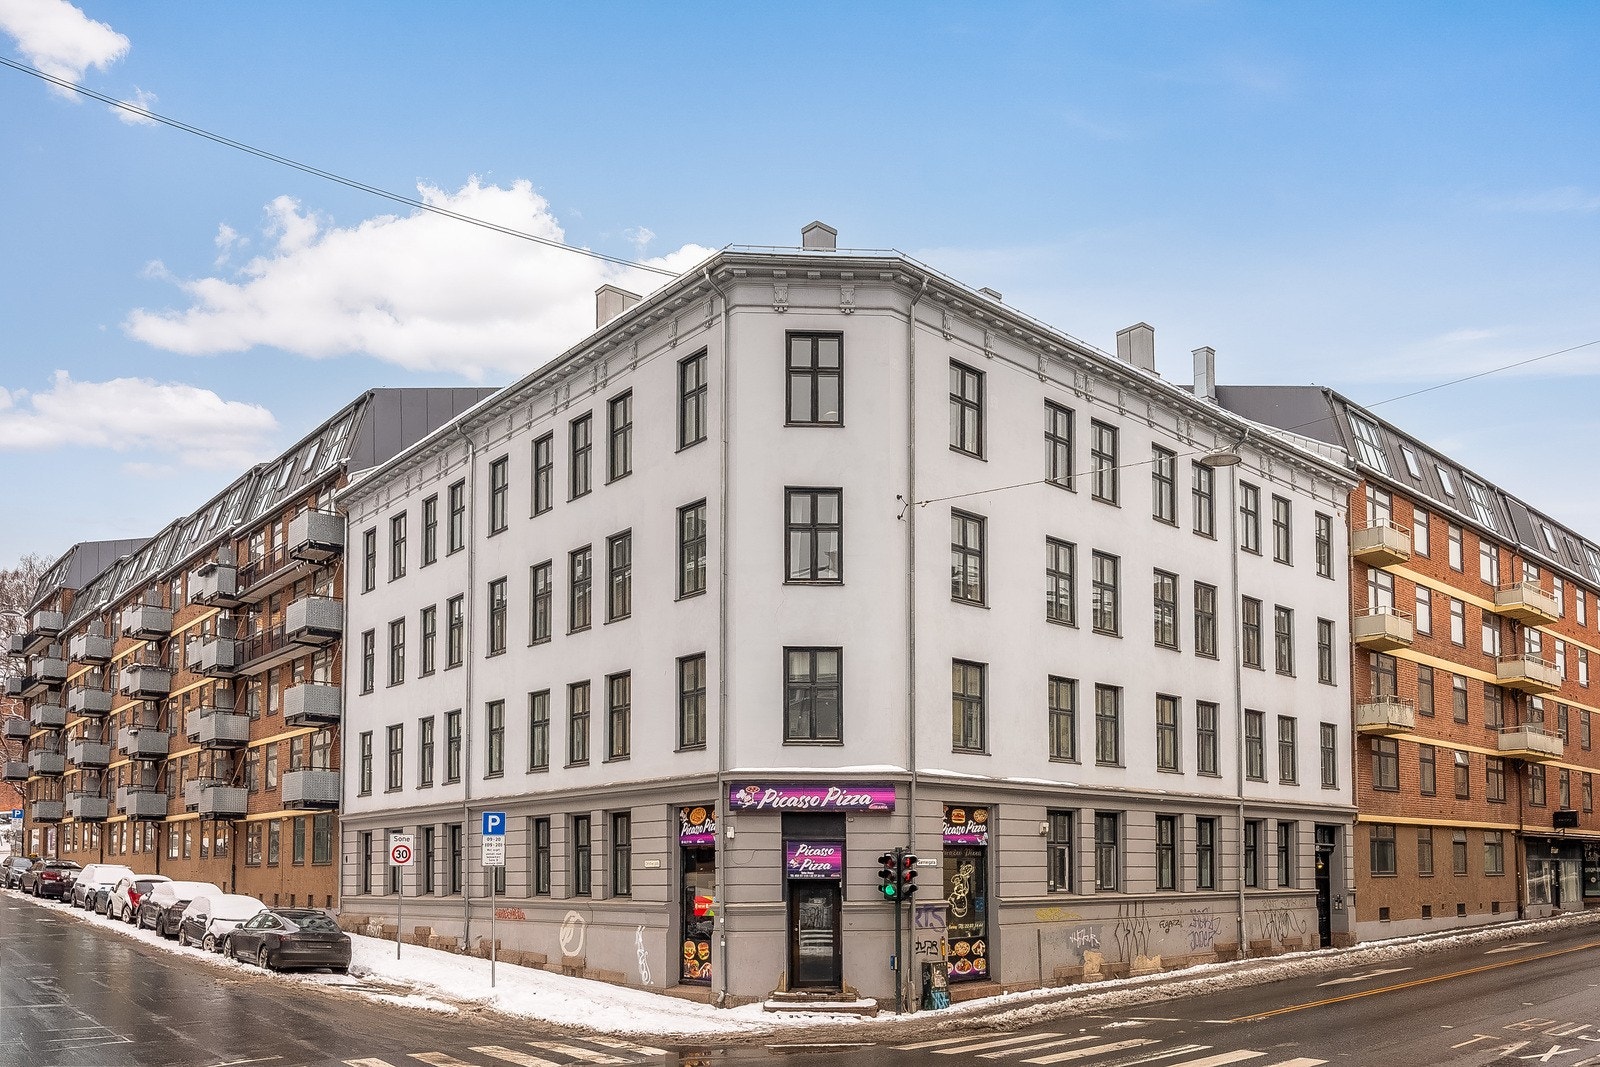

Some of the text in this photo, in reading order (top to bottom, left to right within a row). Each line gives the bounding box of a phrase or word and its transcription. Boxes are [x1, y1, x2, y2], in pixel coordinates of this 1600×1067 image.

[757, 786, 873, 809] Picasso Pizza
[488, 815, 501, 832] P
[681, 822, 704, 836] Picasso
[965, 820, 988, 834] Pizza
[395, 849, 408, 859] 30
[795, 843, 835, 857] Picasso
[799, 858, 832, 871] Pizza
